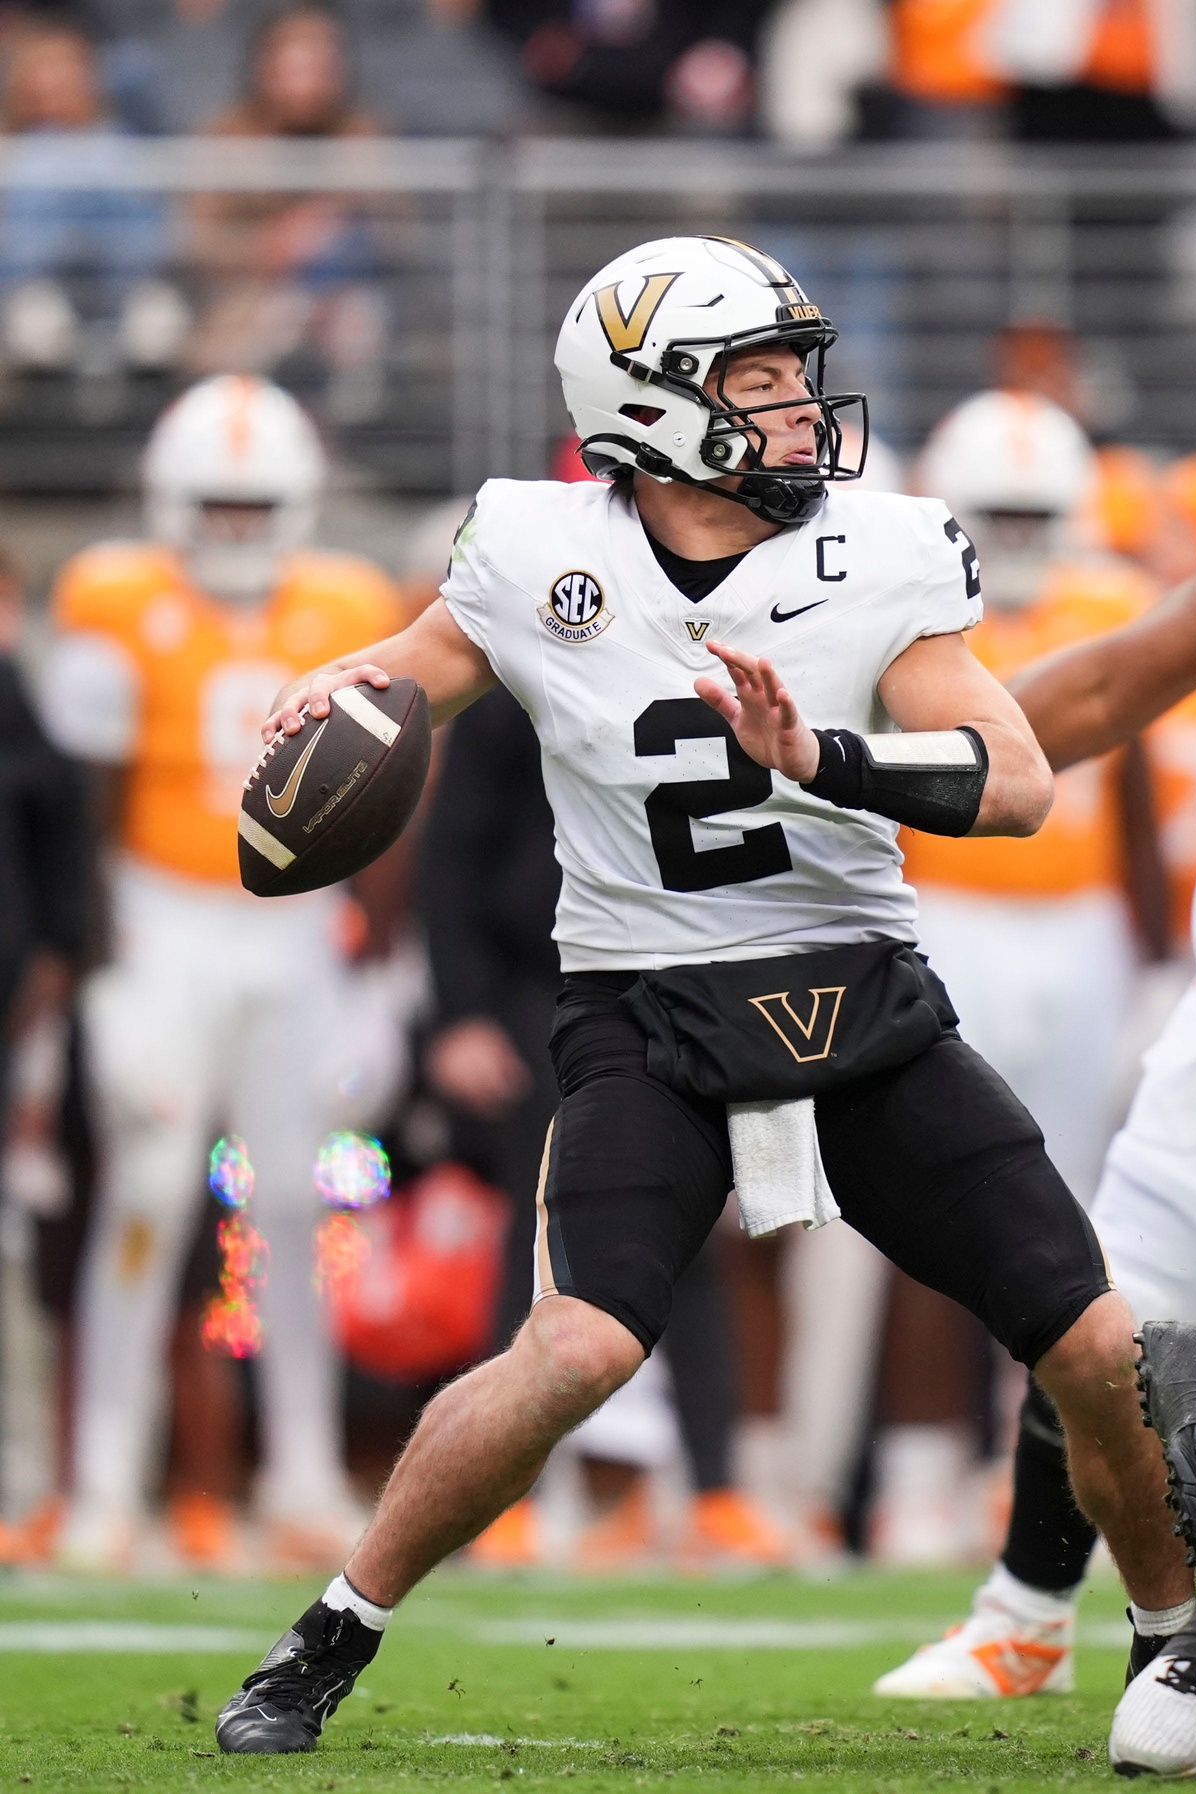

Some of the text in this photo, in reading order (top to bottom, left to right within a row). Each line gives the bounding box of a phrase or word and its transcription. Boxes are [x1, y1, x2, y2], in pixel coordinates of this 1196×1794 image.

[592, 272, 685, 354] V
[816, 535, 847, 581] C
[943, 517, 981, 599] 2
[545, 616, 602, 640] GRADUATE
[554, 574, 600, 623] SEC
[684, 621, 711, 641] V
[634, 697, 793, 892] 2
[748, 987, 847, 1063] V
